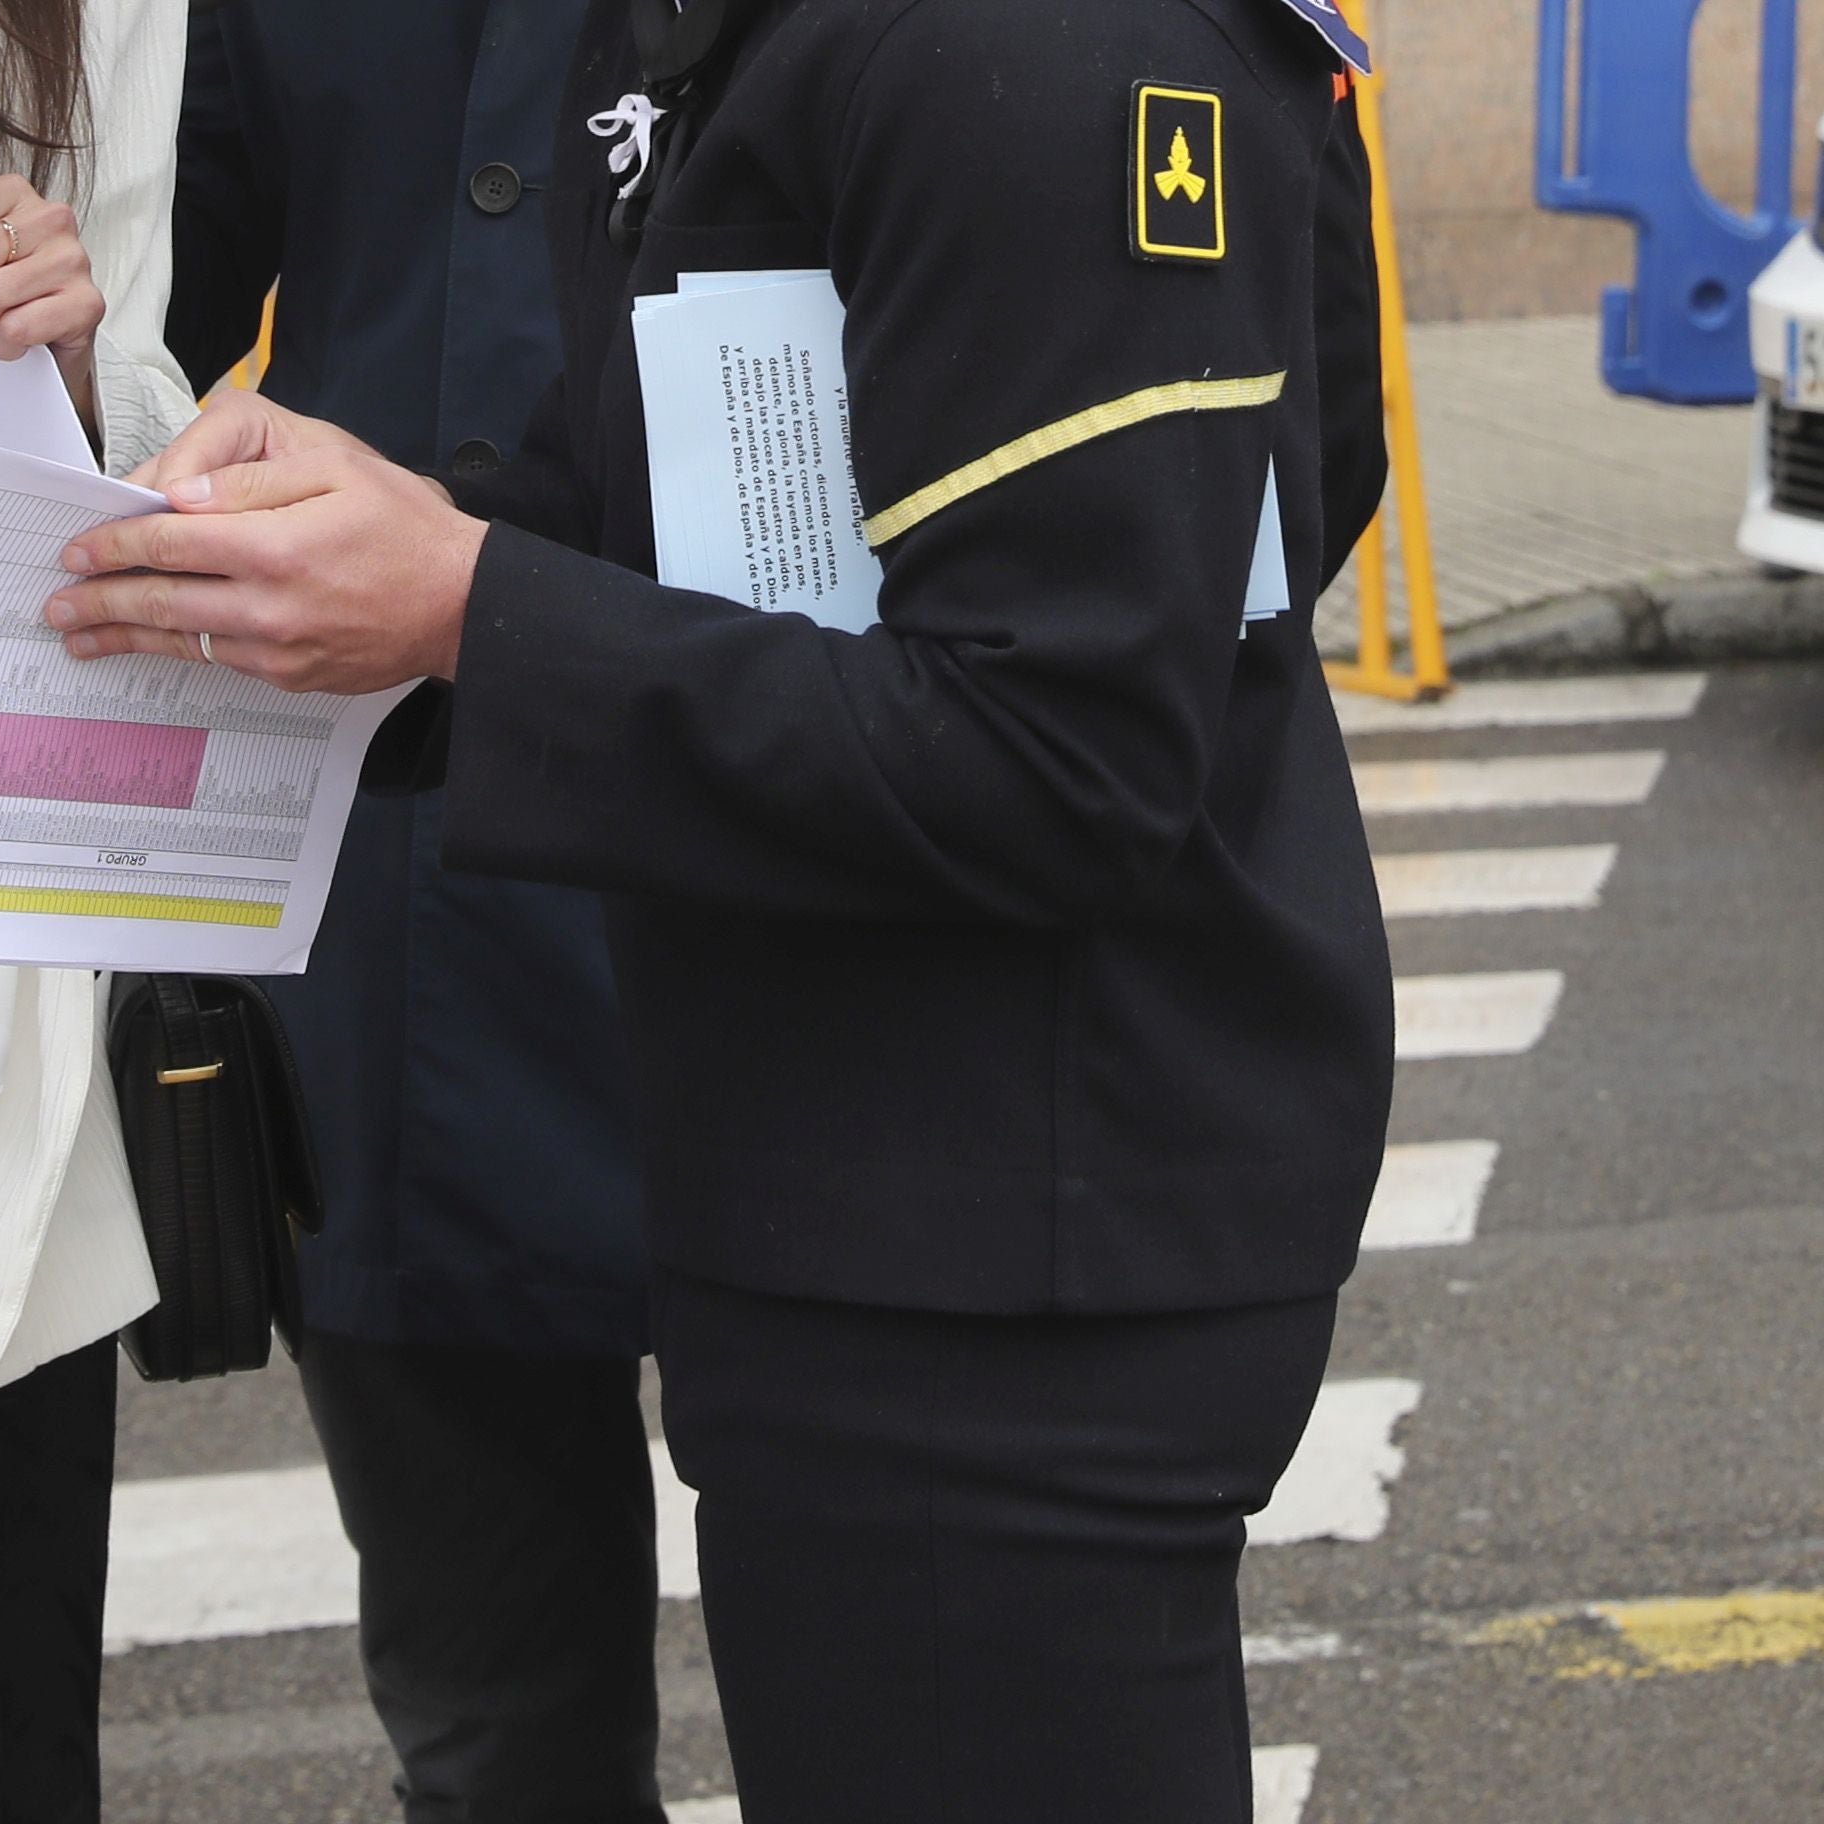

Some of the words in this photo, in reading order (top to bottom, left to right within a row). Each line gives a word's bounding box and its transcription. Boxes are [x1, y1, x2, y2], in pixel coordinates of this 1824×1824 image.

[717, 343, 730, 362] De
[732, 345, 744, 354] y
[735, 357, 751, 397] arriba
[751, 357, 767, 403] debajo
[767, 356, 783, 410] delante,
[781, 342, 797, 396] marinos
[798, 348, 816, 406] Soñando
[720, 364, 737, 412] España
[725, 413, 737, 423] y
[741, 399, 754, 413] el
[757, 404, 769, 425] las
[774, 412, 786, 426] la
[789, 398, 801, 416] de
[728, 425, 741, 443] de
[744, 415, 761, 473] mandato
[760, 427, 774, 466] voces
[774, 428, 792, 471] gloria,
[791, 418, 808, 465] España
[806, 408, 823, 469] victorias,
[731, 445, 745, 479] Dios,
[765, 467, 778, 485] de
[736, 481, 749, 499] de
[751, 475, 764, 493] de
[782, 473, 795, 487] la
[768, 486, 785, 545] nuestros
[784, 489, 802, 541] leyenda
[798, 467, 815, 531] crucemos
[814, 472, 832, 527] diciendo
[738, 501, 755, 549] España
[754, 495, 771, 542] España
[743, 550, 755, 560] y
[758, 544, 771, 554] y
[792, 543, 803, 560] en
[806, 533, 818, 553] los
[822, 529, 839, 591] cantares,
[747, 562, 759, 579] de
[762, 556, 775, 574] de
[776, 547, 792, 593] caídos,
[792, 563, 807, 591] pos,
[809, 555, 824, 601] mares,
[765, 576, 778, 610] Dios.
[105, 852, 147, 866] GRUPO
